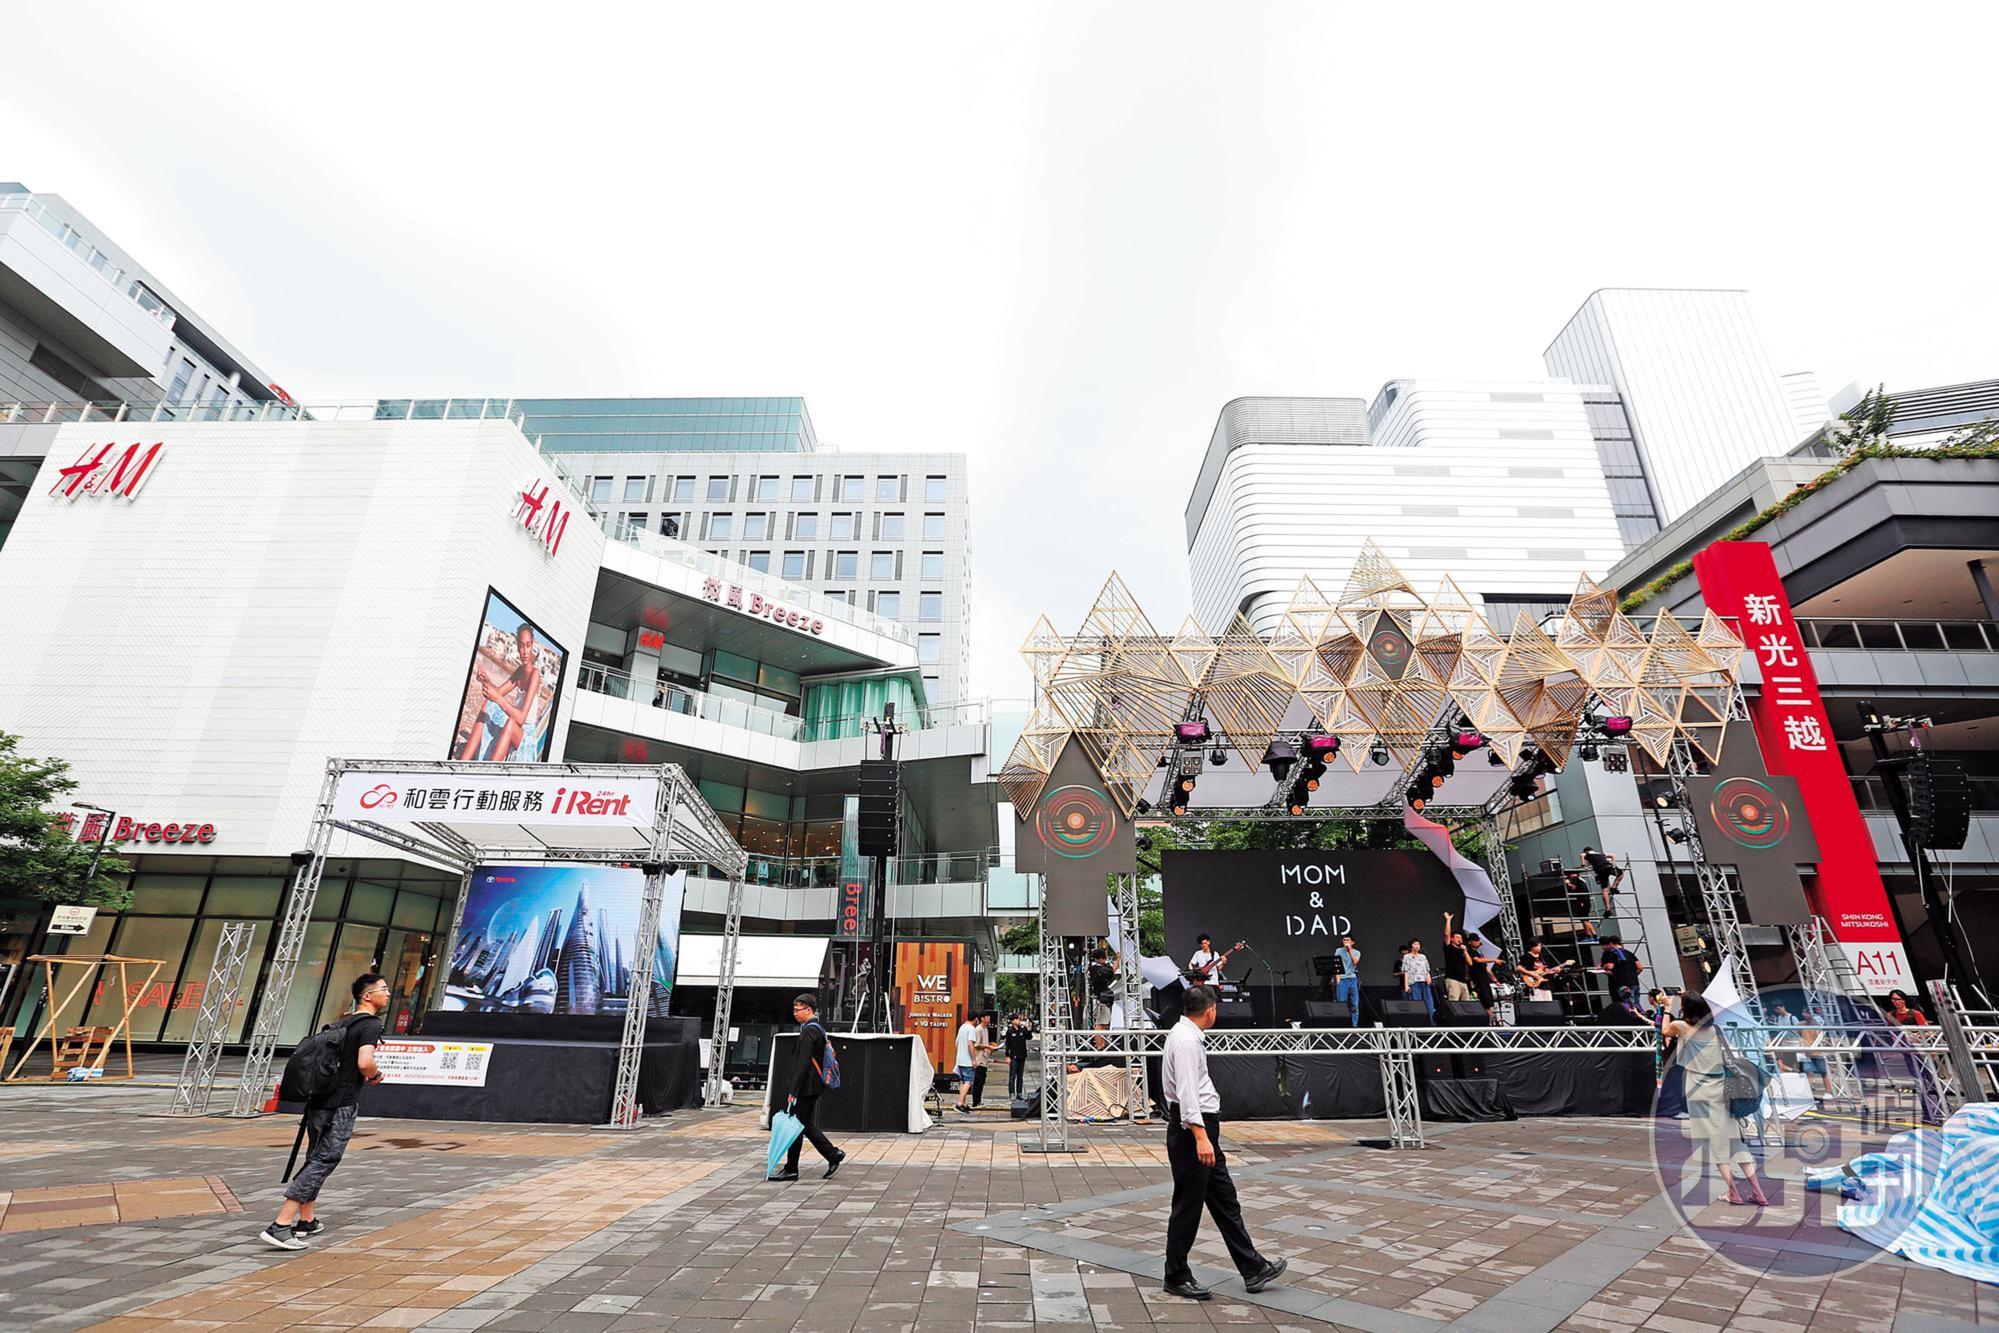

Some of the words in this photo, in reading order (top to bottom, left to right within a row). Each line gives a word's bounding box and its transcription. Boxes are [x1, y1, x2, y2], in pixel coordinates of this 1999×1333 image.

[48, 442, 164, 497] H&M
[515, 478, 570, 557] H&M
[751, 593, 824, 634] Breeze
[1743, 593, 1827, 750] 新光三越
[403, 788, 544, 812] 和雲行動服務
[113, 816, 214, 843] Breeze
[1281, 864, 1345, 884] MOM
[1309, 891, 1324, 908] &
[1286, 914, 1351, 936] DAD
[1857, 951, 1901, 975] A11
[917, 975, 947, 990] WE
[914, 995, 950, 1003] BISTRO
